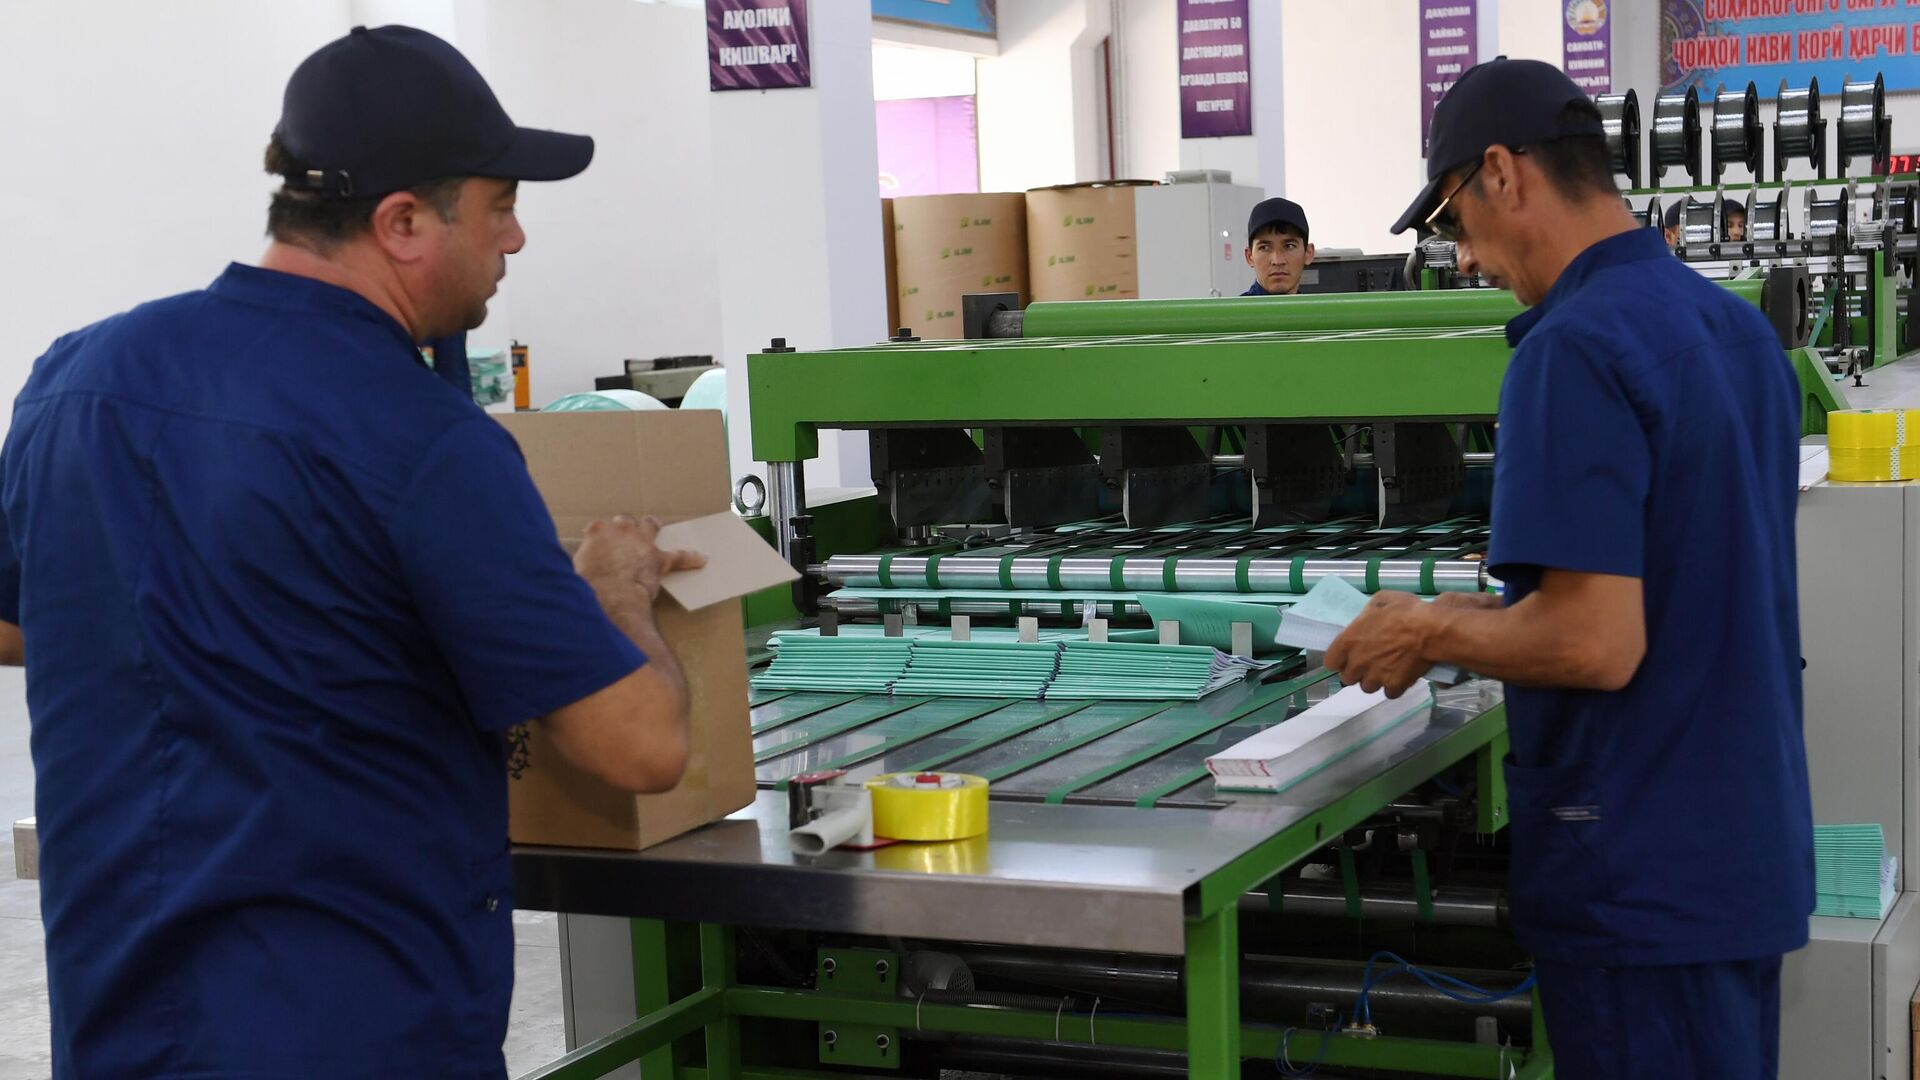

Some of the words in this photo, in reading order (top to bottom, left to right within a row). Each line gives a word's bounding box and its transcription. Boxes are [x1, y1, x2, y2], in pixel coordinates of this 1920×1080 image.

[723, 7, 790, 30] АҲОЛИИ
[719, 44, 797, 66] КИШВАР!
[1747, 34, 1792, 65] НАВИ
[1849, 25, 1906, 61] ҲАРЧИ
